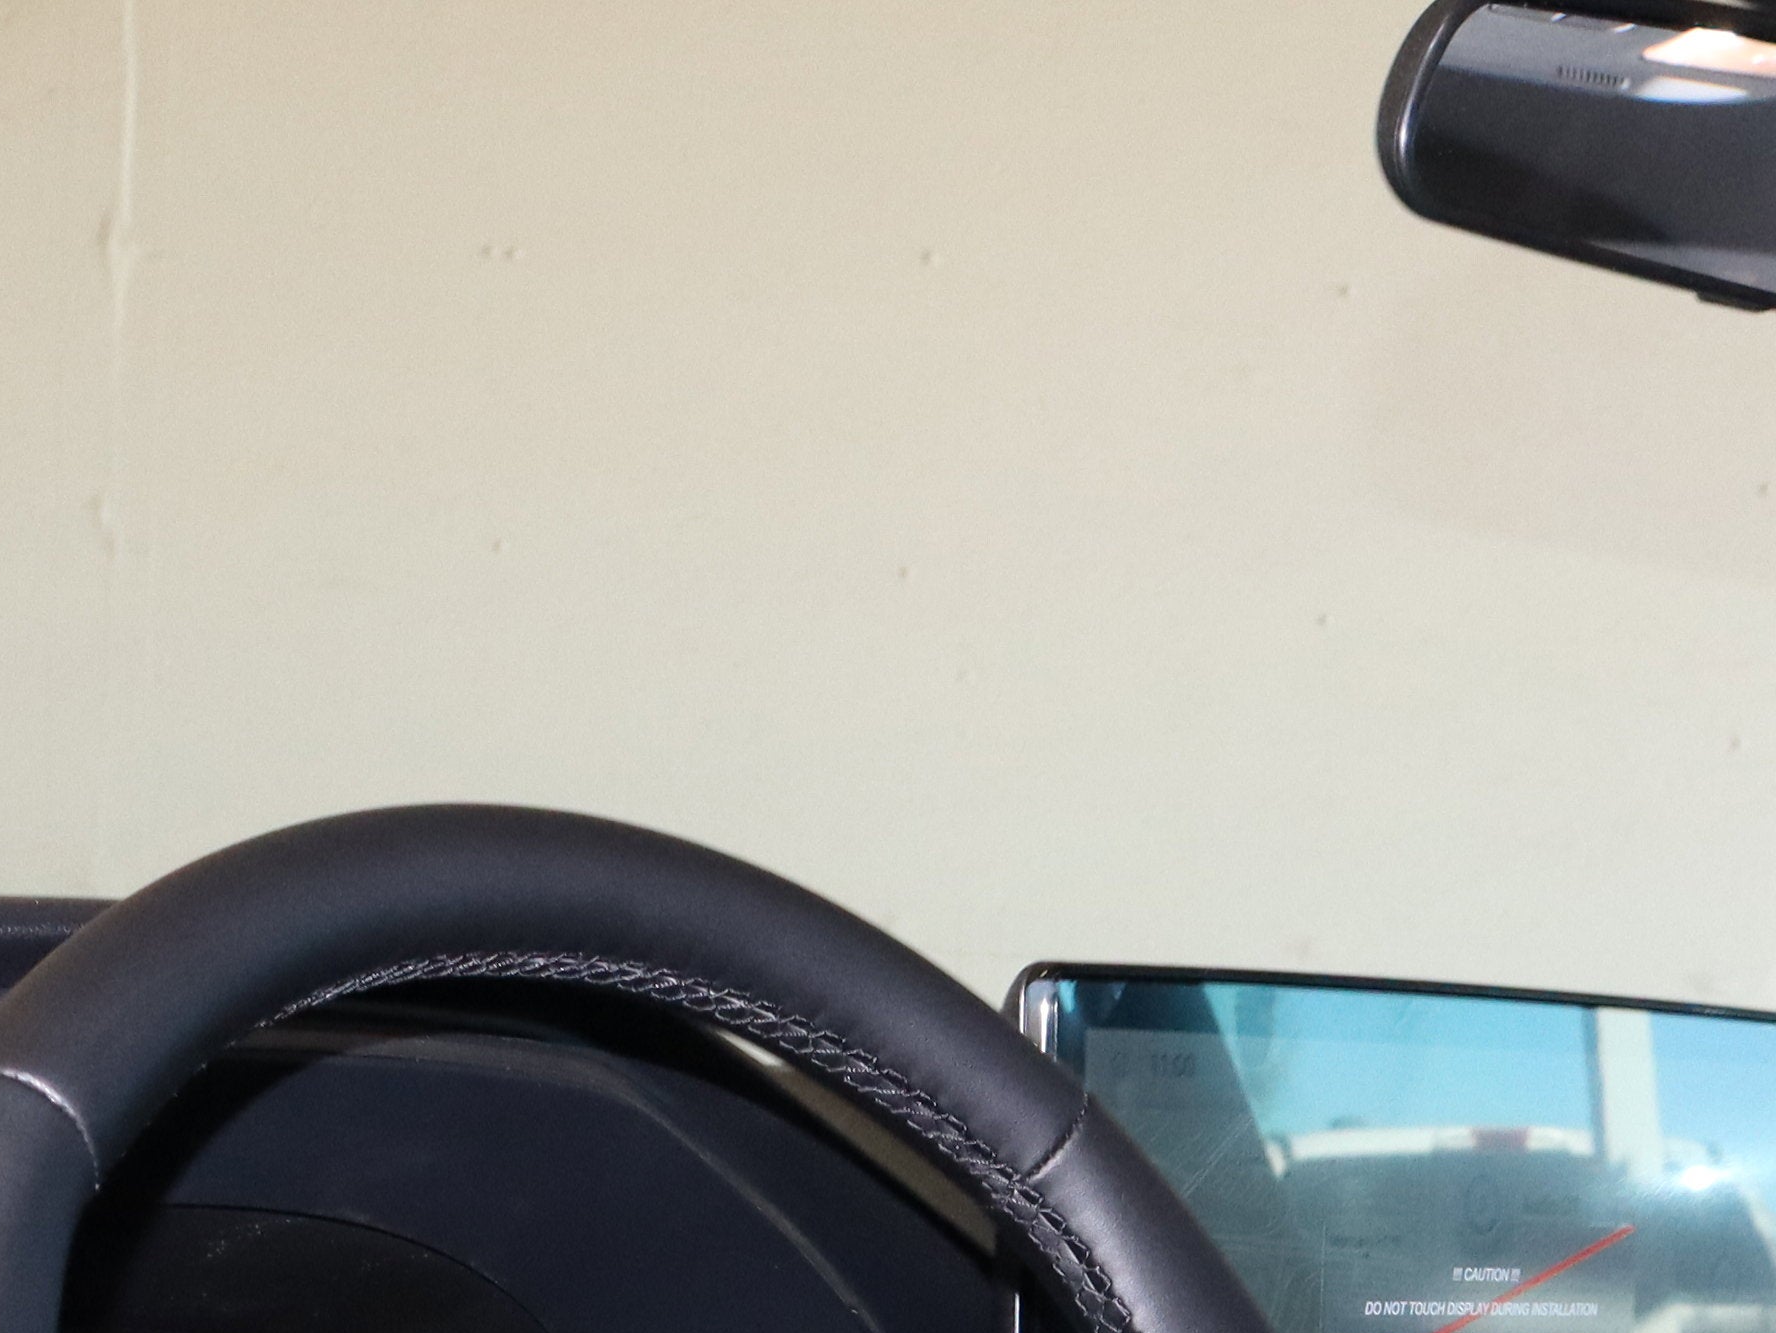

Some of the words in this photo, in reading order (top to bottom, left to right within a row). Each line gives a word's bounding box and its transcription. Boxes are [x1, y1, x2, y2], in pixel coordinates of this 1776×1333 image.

[1464, 1267, 1510, 1282] CAUTION
[1365, 1301, 1381, 1316] DO
[1383, 1301, 1407, 1316] NOT
[1409, 1301, 1445, 1316] TOUCH
[1446, 1301, 1490, 1316] DISPLAY
[1490, 1301, 1531, 1316] DURING
[1531, 1301, 1598, 1316] INSTALLATION
